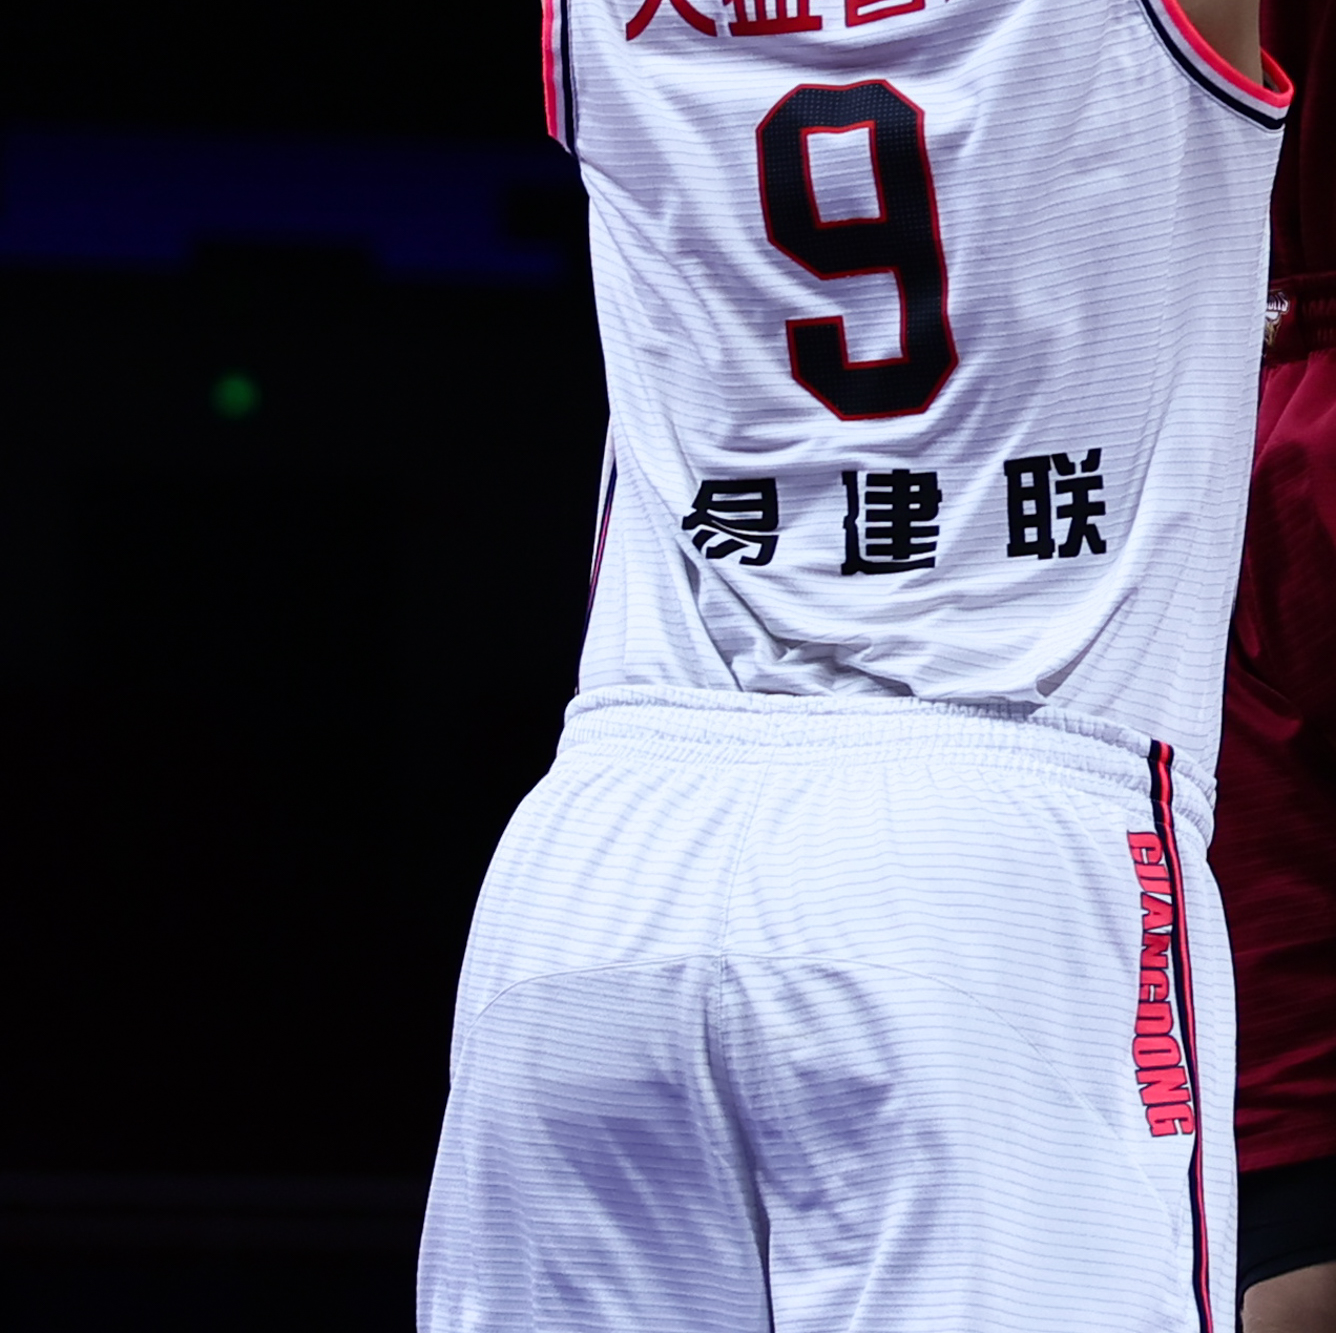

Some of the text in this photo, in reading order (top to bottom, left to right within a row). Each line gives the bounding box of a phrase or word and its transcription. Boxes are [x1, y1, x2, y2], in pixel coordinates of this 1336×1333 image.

[755, 78, 959, 422] 9
[681, 447, 1107, 576] 易建联
